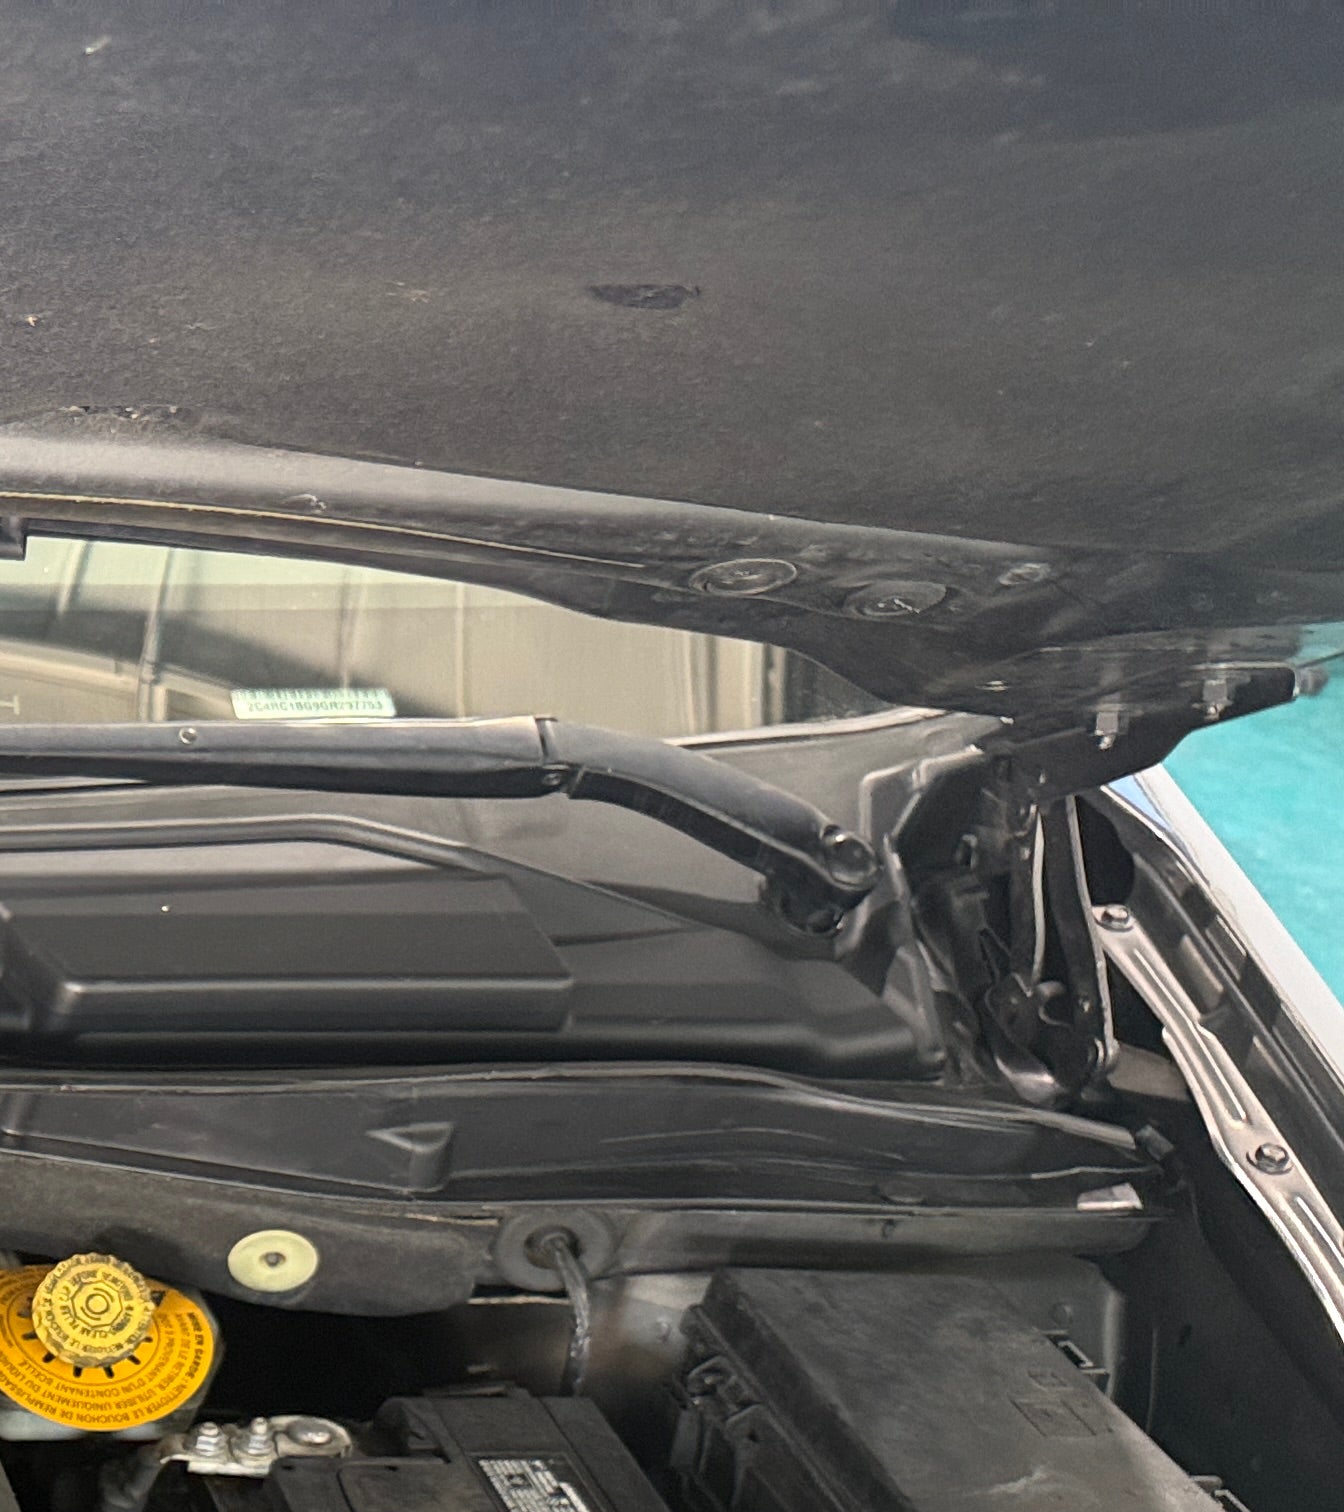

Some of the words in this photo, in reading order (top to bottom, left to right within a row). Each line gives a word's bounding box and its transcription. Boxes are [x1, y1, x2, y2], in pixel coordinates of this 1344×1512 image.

[56, 1382, 120, 1399] CONTENANT
[42, 1390, 112, 1412] UNIQUEMENT
[76, 1411, 130, 1424] BOUCHON
